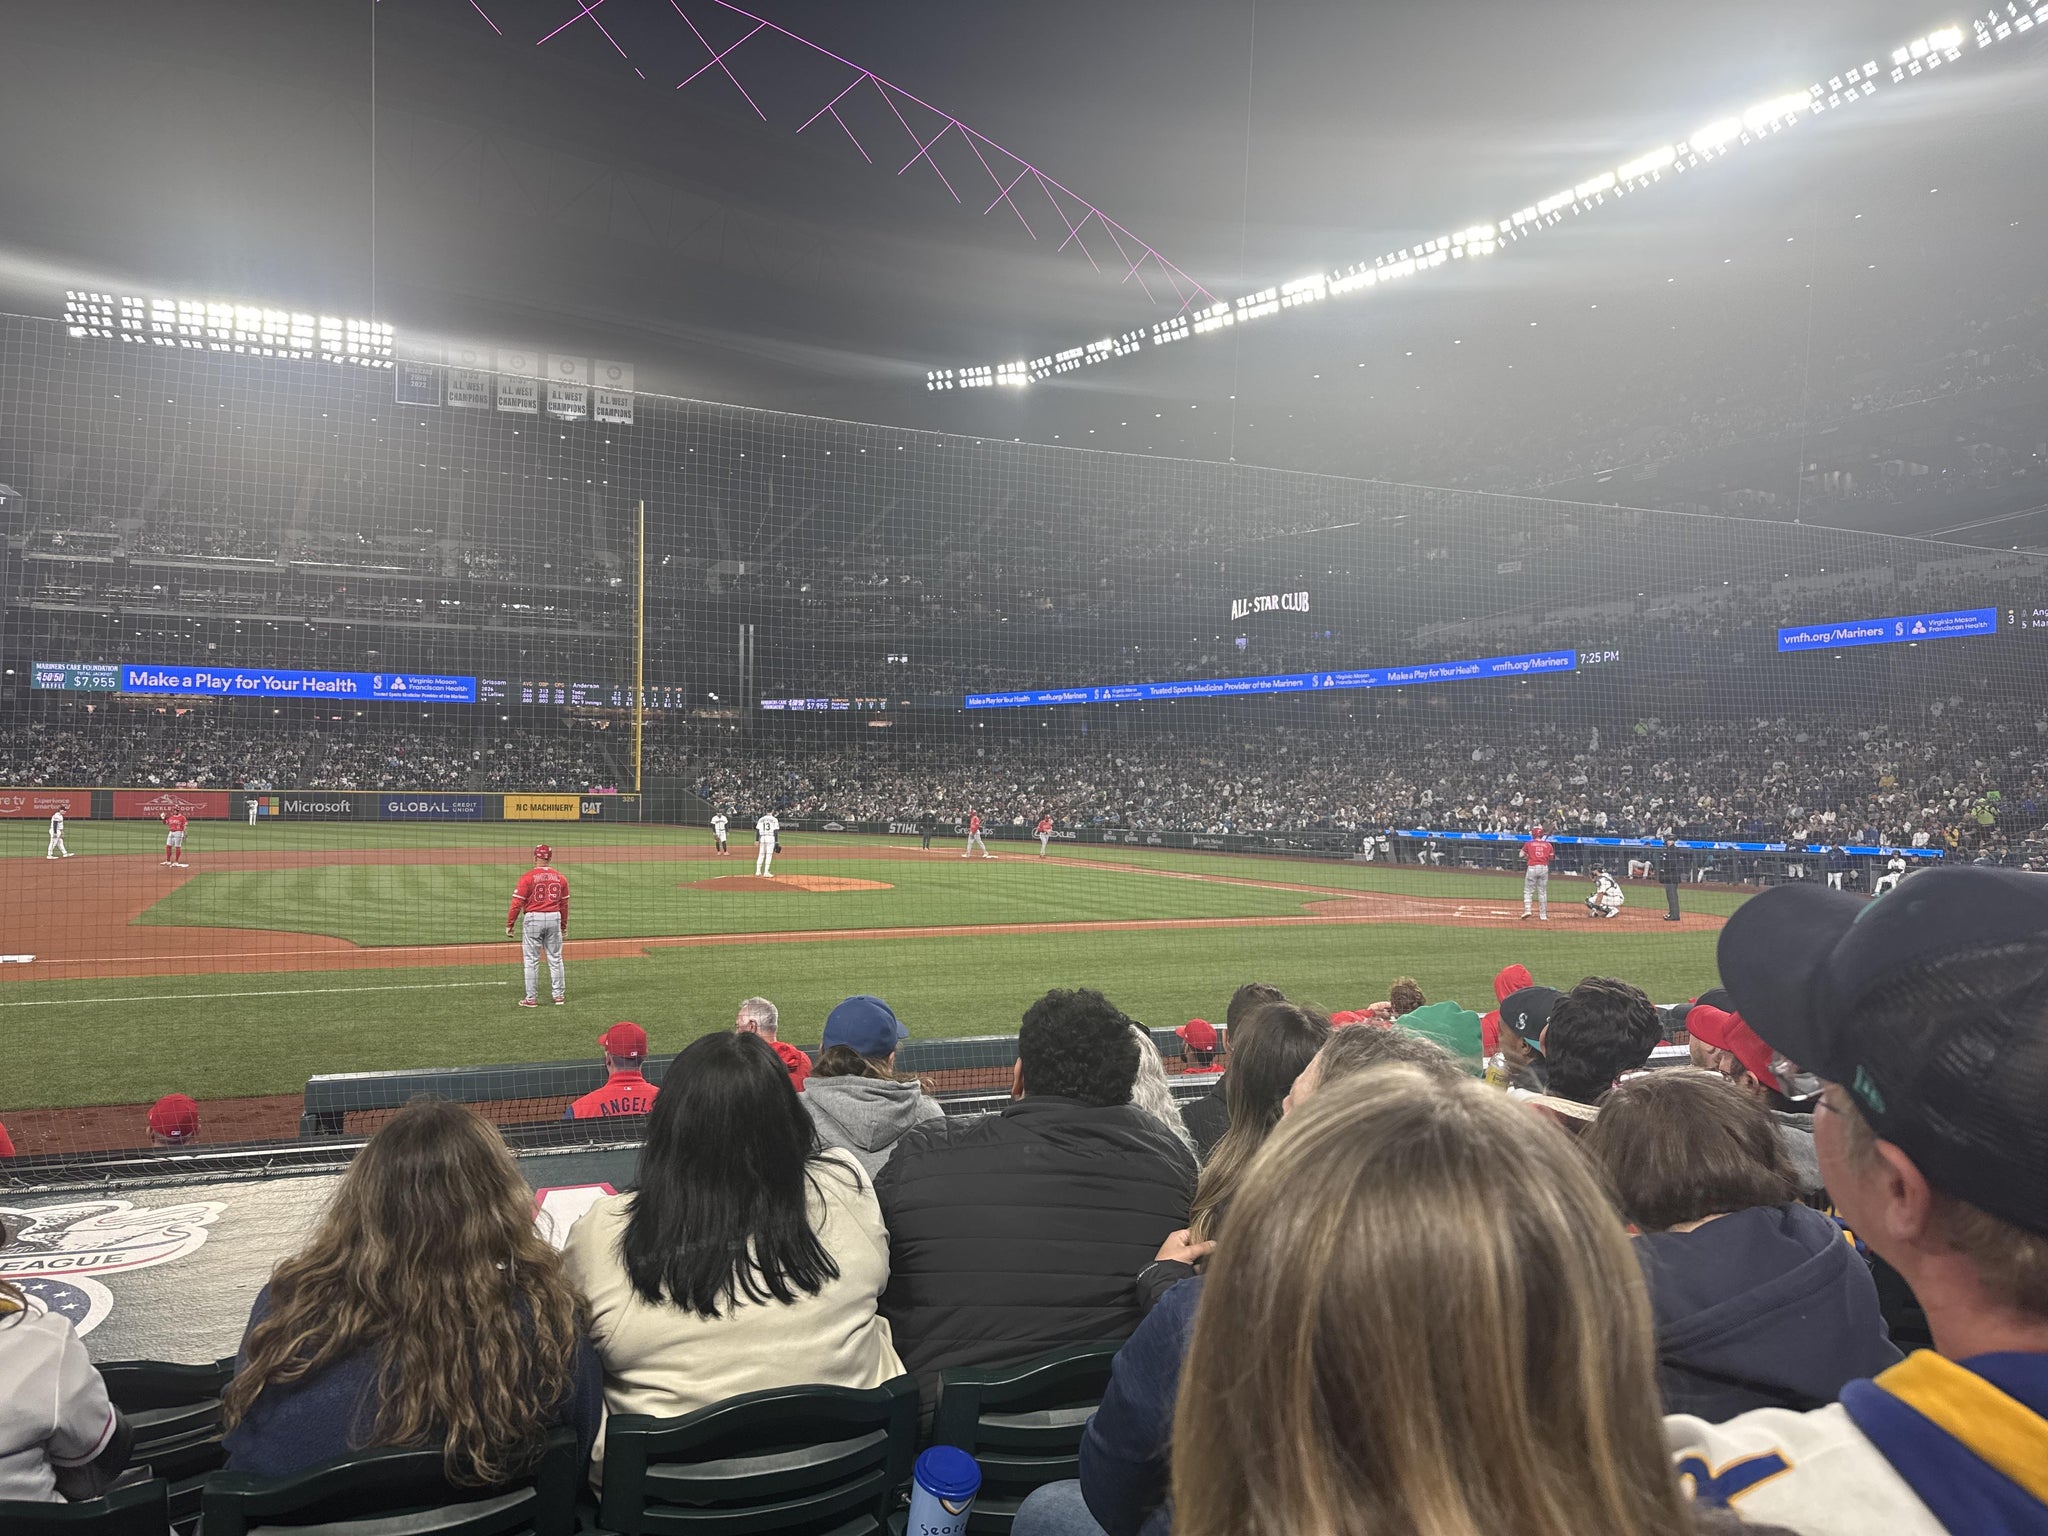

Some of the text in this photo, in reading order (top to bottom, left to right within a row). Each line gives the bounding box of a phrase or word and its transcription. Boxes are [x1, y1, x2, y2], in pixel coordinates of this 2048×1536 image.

[466, 382, 484, 391] WEST
[516, 387, 532, 396] WEST
[449, 392, 488, 403] CHAMPIONS
[565, 392, 582, 401] WEST
[612, 397, 628, 406] WEST
[498, 397, 537, 409] CHAMPIONS
[548, 402, 586, 414] CHAMPIONS
[596, 407, 632, 418] CHAMPIONS
[1281, 591, 1309, 612] CLUB
[1954, 616, 1977, 624] Mason
[1784, 626, 1884, 644] vmfh.org/Mariners
[1580, 650, 1619, 664] 7:25 PM
[1492, 657, 1569, 671] vmfh.org/Mariners
[1388, 672, 1408, 680] Make
[1414, 670, 1428, 680] Play
[1429, 668, 1439, 677] for
[1440, 667, 1455, 676] Your
[1456, 664, 1480, 675] Health
[74, 676, 115, 688] $7,955
[129, 671, 357, 692] Make a Play for Your Health
[1150, 679, 1303, 695] Trusted Sports Medicine Provider of the Mariners
[13, 796, 25, 805] tv
[284, 800, 350, 812] Microsoft
[388, 802, 449, 812] GLOBAL
[582, 802, 601, 814] CAT
[763, 823, 771, 831] 13
[889, 823, 919, 834] STIHL
[600, 1097, 656, 1116] ANGEL
